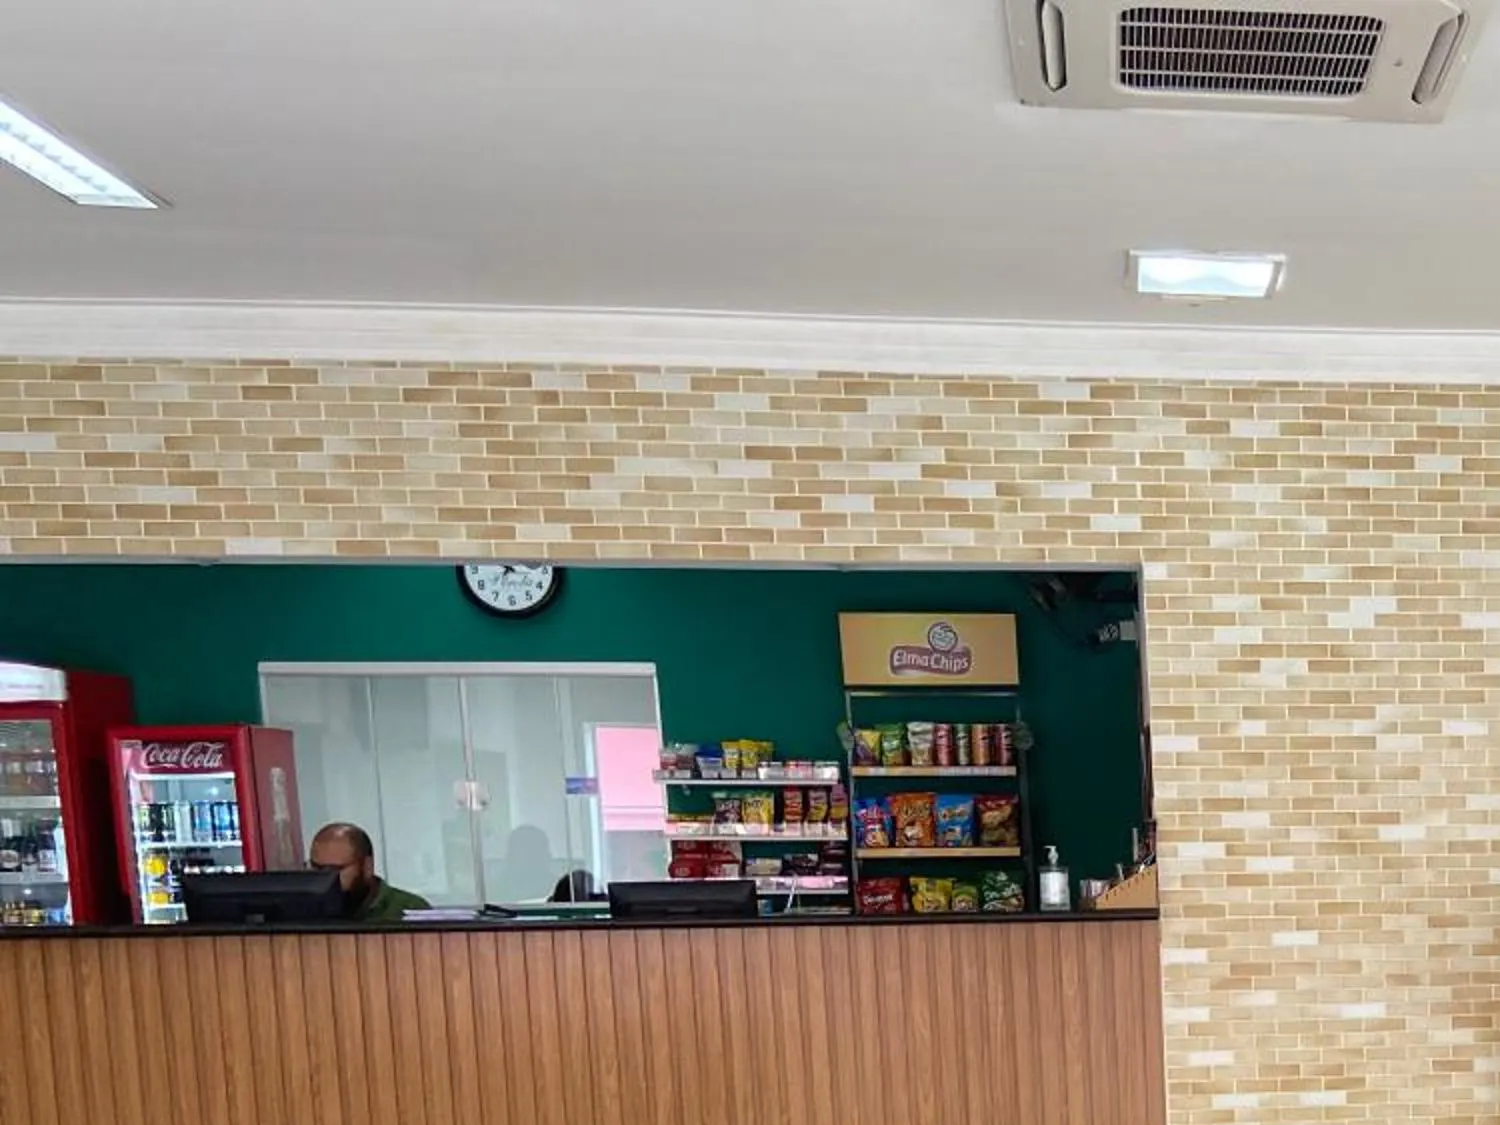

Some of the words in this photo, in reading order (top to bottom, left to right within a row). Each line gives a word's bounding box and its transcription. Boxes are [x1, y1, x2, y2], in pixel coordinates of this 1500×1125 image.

[536, 581, 543, 590] 4
[508, 595, 516, 606] 6
[893, 649, 929, 667] Elma
[930, 653, 969, 673] Chips
